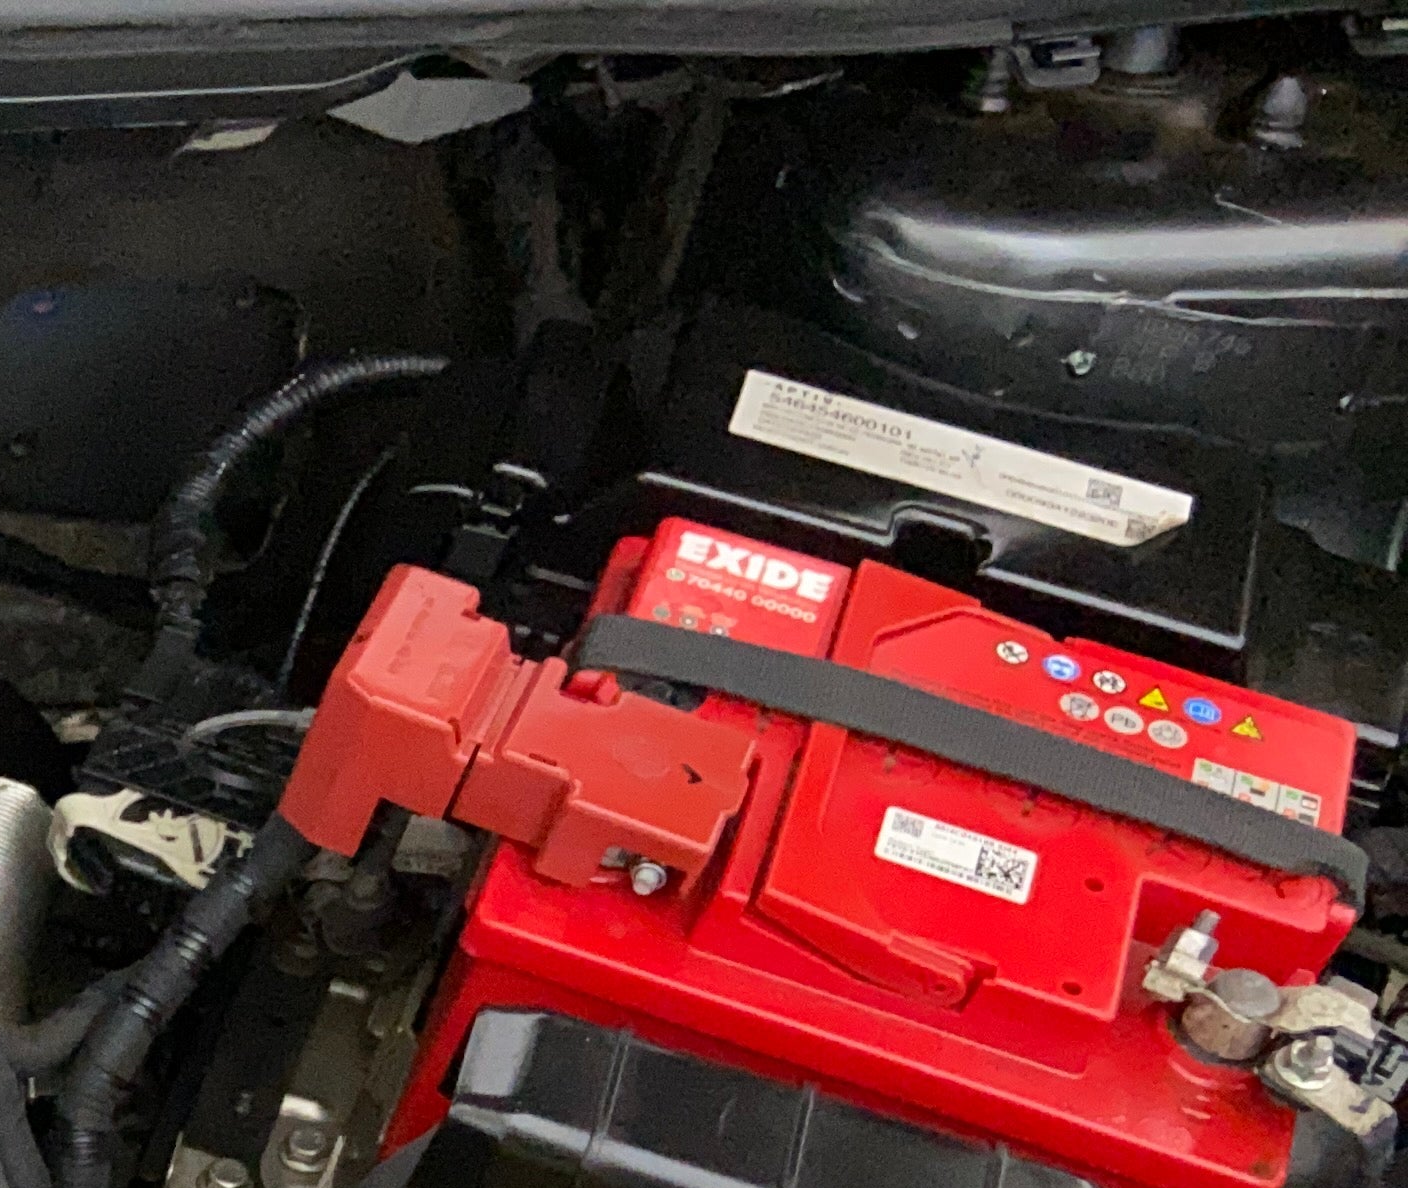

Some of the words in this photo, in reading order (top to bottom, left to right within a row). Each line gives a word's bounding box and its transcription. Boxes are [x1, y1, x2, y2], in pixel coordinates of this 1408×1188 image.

[677, 530, 835, 603] EXIDE
[687, 574, 748, 602] 70440
[750, 594, 818, 624] 00000
